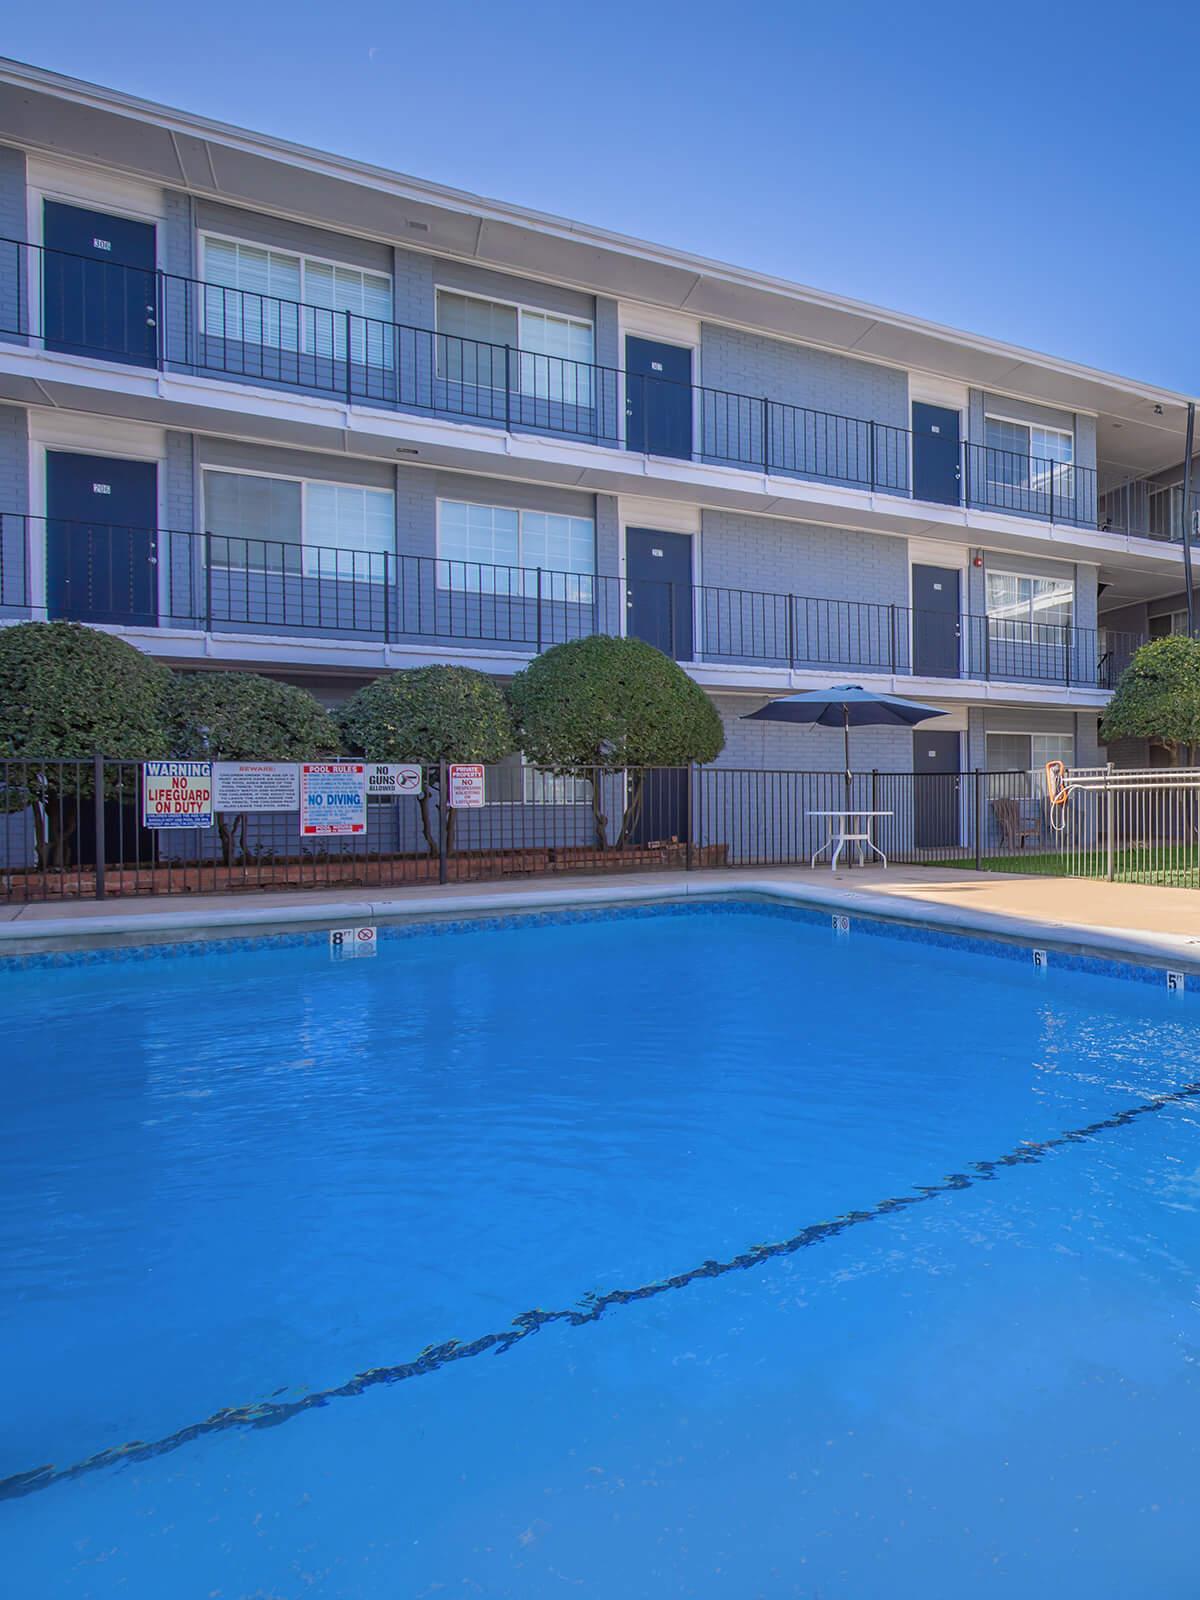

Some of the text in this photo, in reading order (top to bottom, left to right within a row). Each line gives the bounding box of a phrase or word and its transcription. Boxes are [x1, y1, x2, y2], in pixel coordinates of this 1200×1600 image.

[147, 763, 210, 776] WARNING
[376, 766, 389, 775] NO
[172, 777, 188, 789] NO
[369, 775, 396, 785] GUNS
[148, 789, 210, 801] LIFEGUARD
[308, 794, 361, 805] NO DIVING
[155, 801, 203, 813] ON DUTY
[332, 931, 344, 945] 8
[1034, 951, 1042, 966] 6
[1168, 974, 1177, 990] 5
